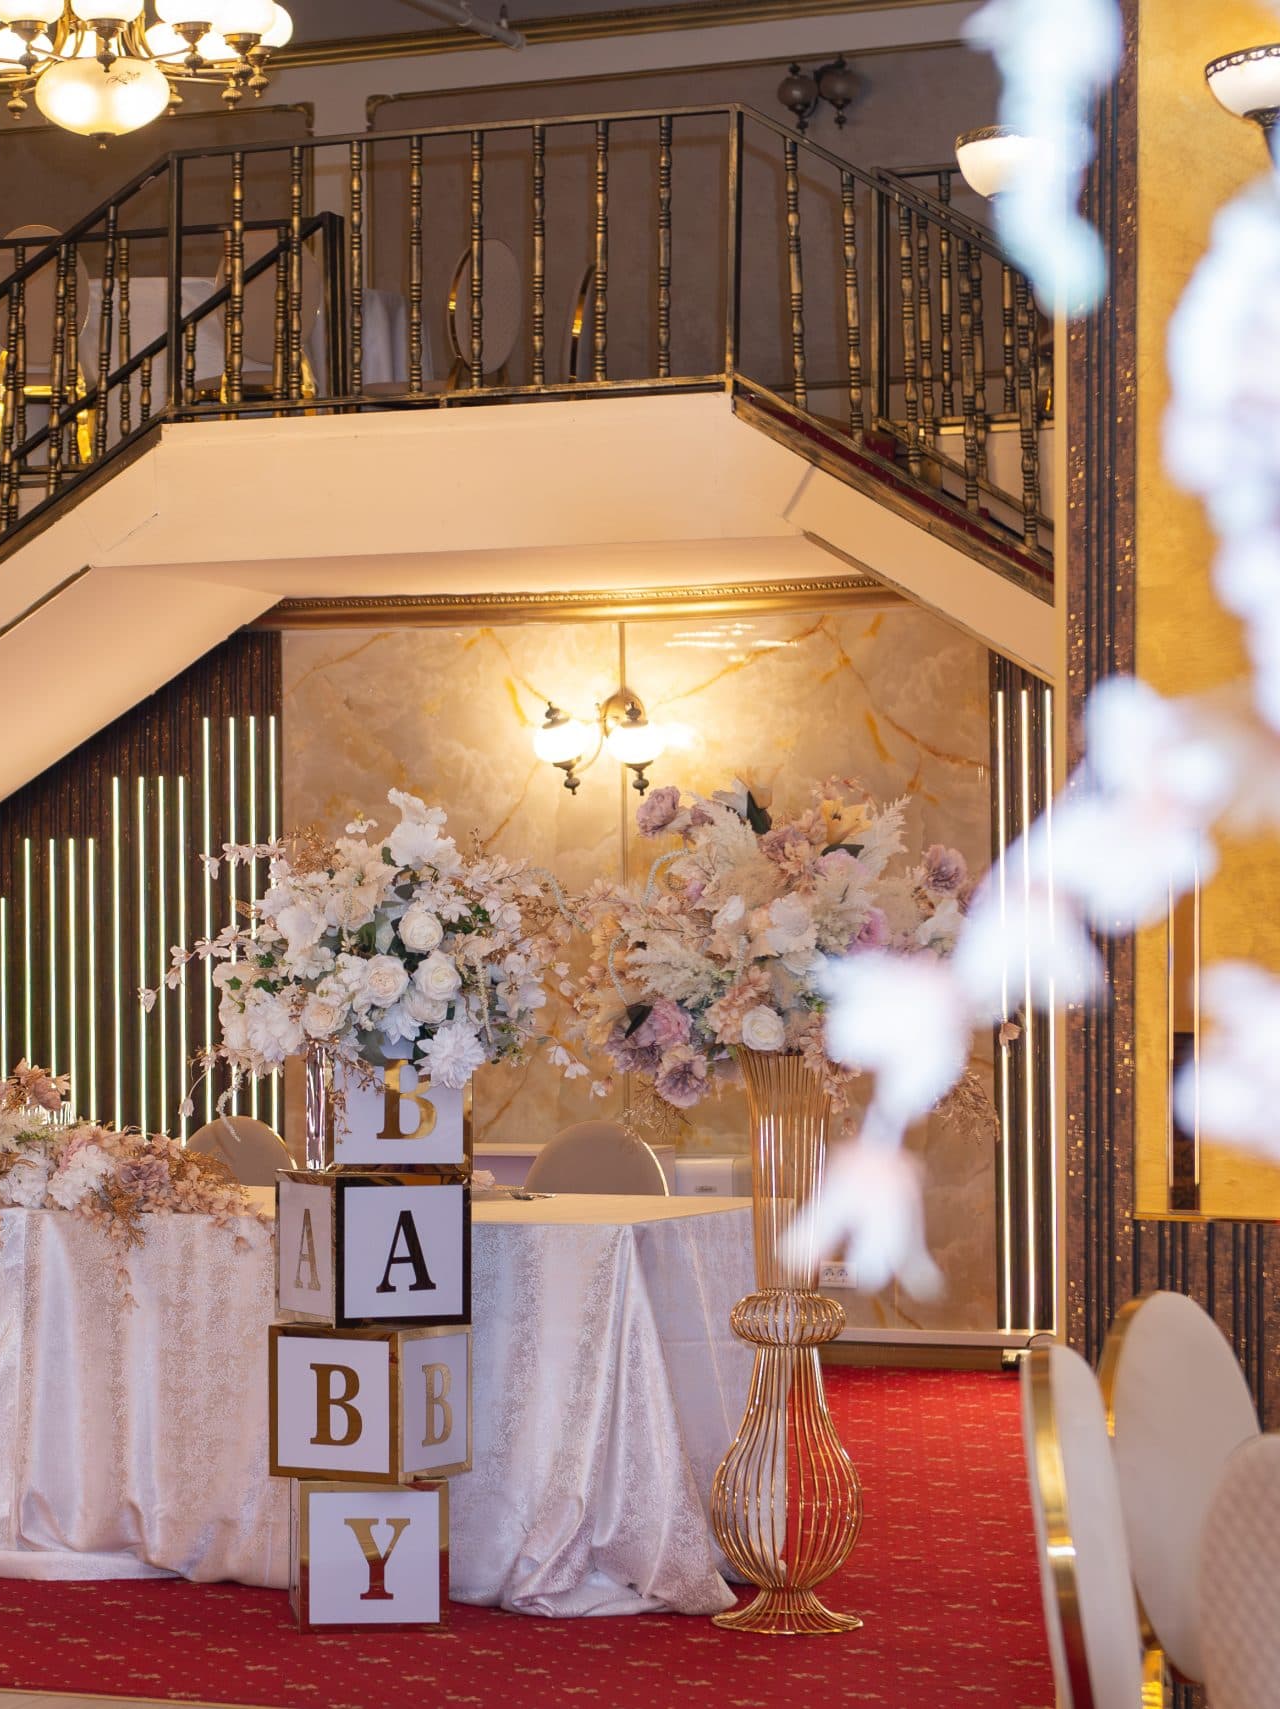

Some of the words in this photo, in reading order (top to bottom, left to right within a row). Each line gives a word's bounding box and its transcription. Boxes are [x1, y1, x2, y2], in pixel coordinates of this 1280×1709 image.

[376, 1058, 438, 1140] B
[294, 1208, 321, 1292] A
[376, 1210, 437, 1294] A
[309, 1362, 363, 1447] B
[421, 1362, 453, 1448] B
[344, 1518, 411, 1601] Y
